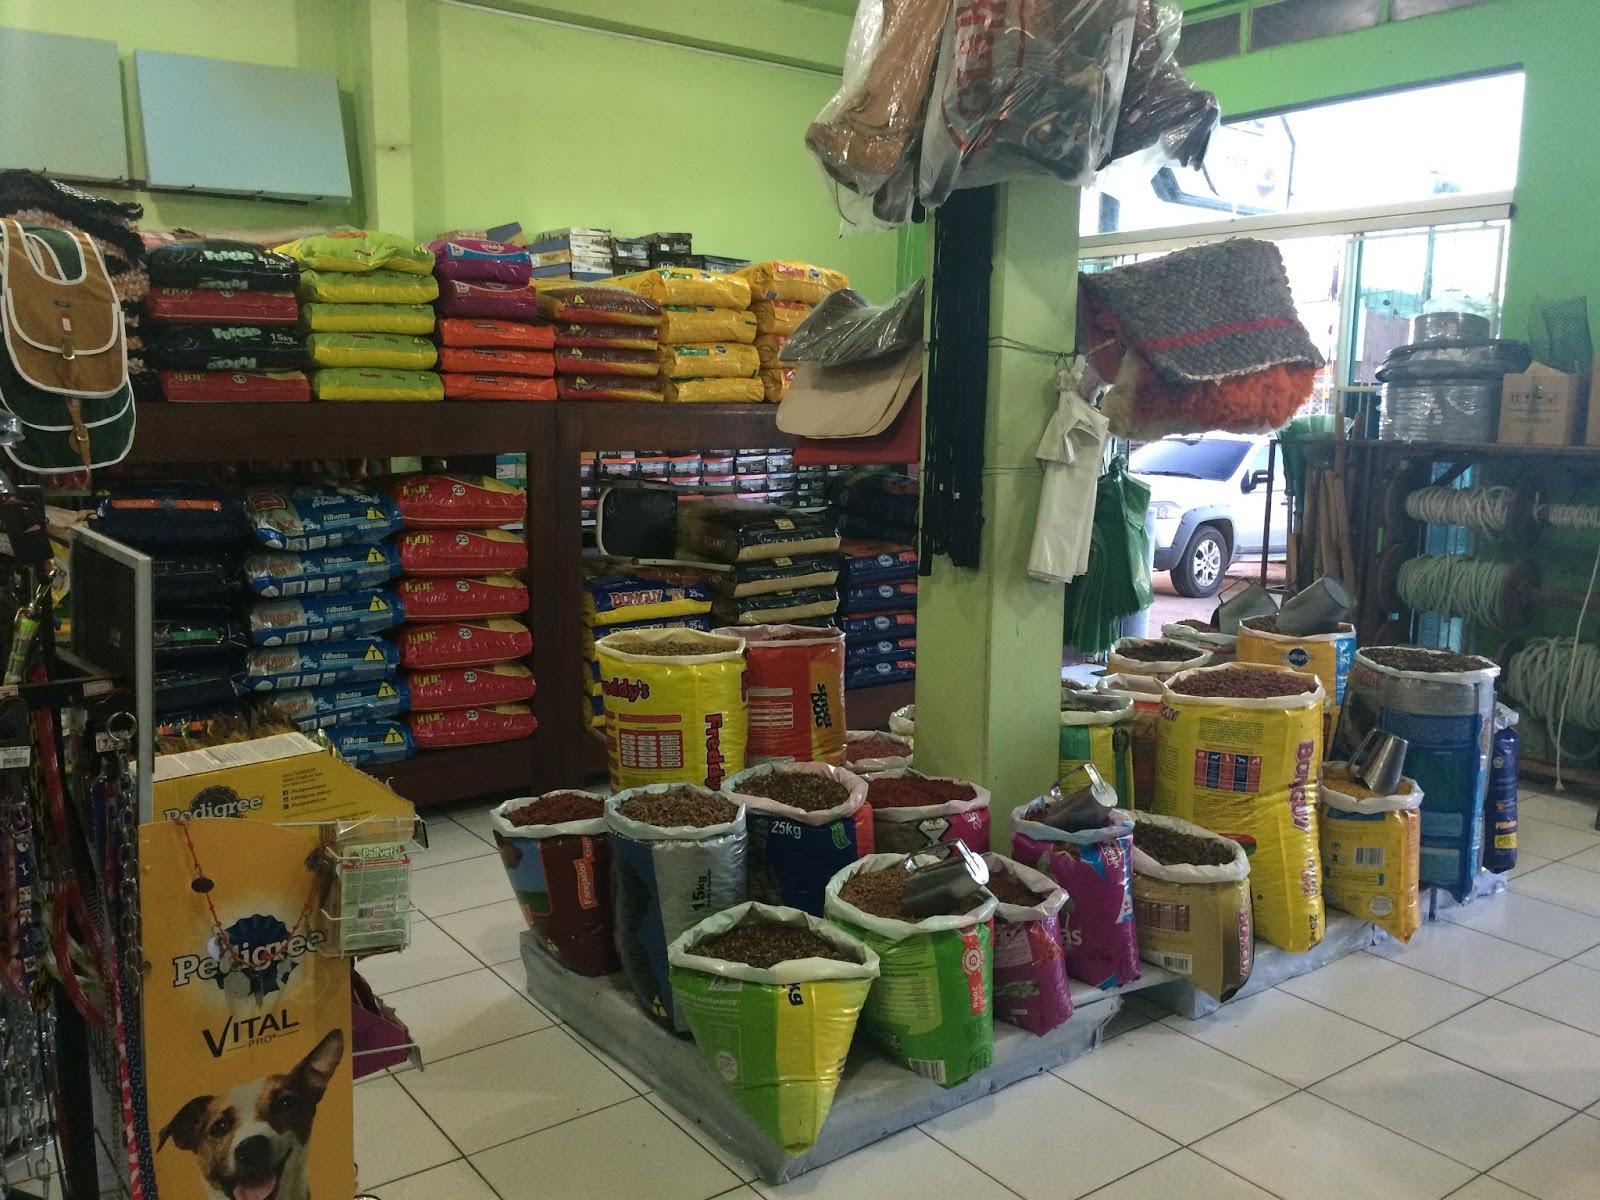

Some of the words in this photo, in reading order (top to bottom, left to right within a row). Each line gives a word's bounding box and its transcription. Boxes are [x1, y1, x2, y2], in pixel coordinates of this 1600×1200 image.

[163, 796, 263, 823] Pedigree
[771, 820, 801, 840] 25kg
[692, 876, 708, 912] 15kg
[173, 930, 326, 988] Peigree
[202, 1009, 299, 1058] VITAL
[248, 1034, 273, 1048] PRO
